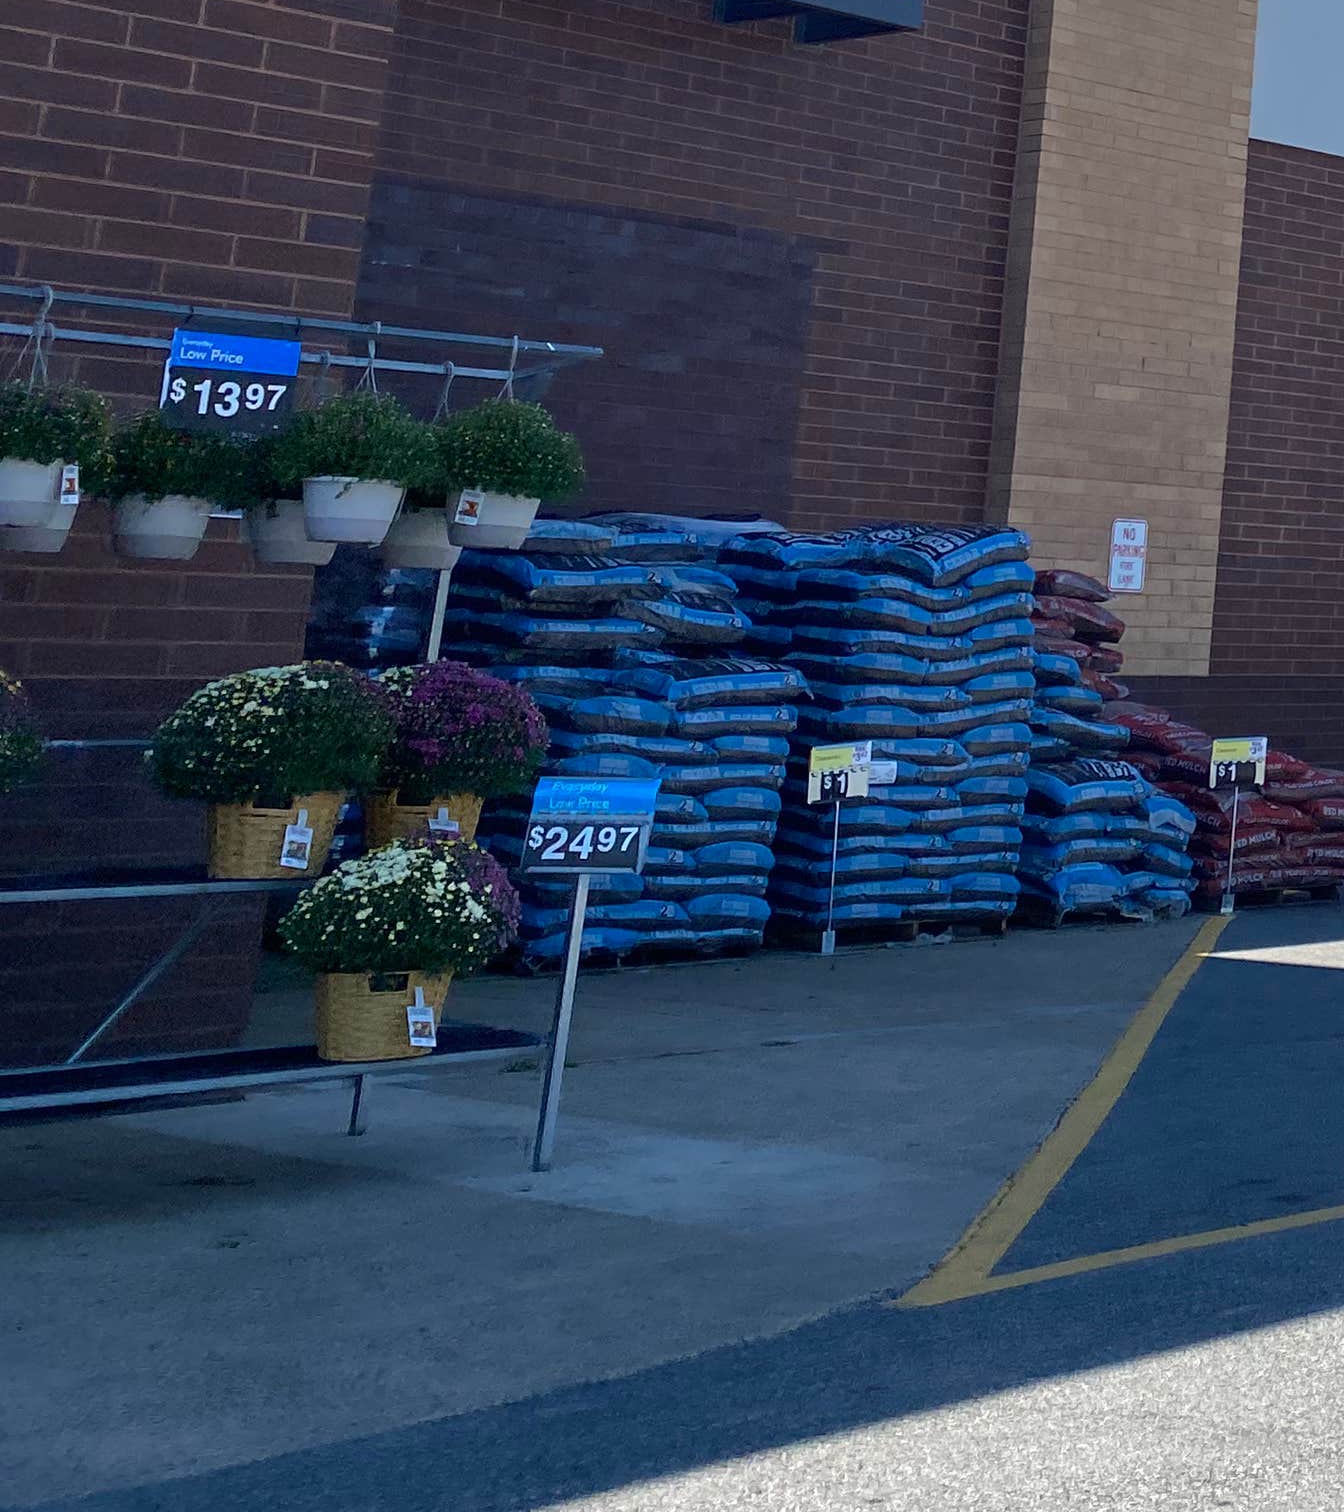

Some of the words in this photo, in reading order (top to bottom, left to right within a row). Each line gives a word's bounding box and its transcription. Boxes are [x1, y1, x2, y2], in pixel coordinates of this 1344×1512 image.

[180, 347, 207, 360] Low
[211, 349, 244, 365] Price
[1122, 527, 1136, 541] NO
[1112, 543, 1145, 558] PARKING
[1177, 759, 1206, 774] MULCH
[578, 797, 610, 810] Price
